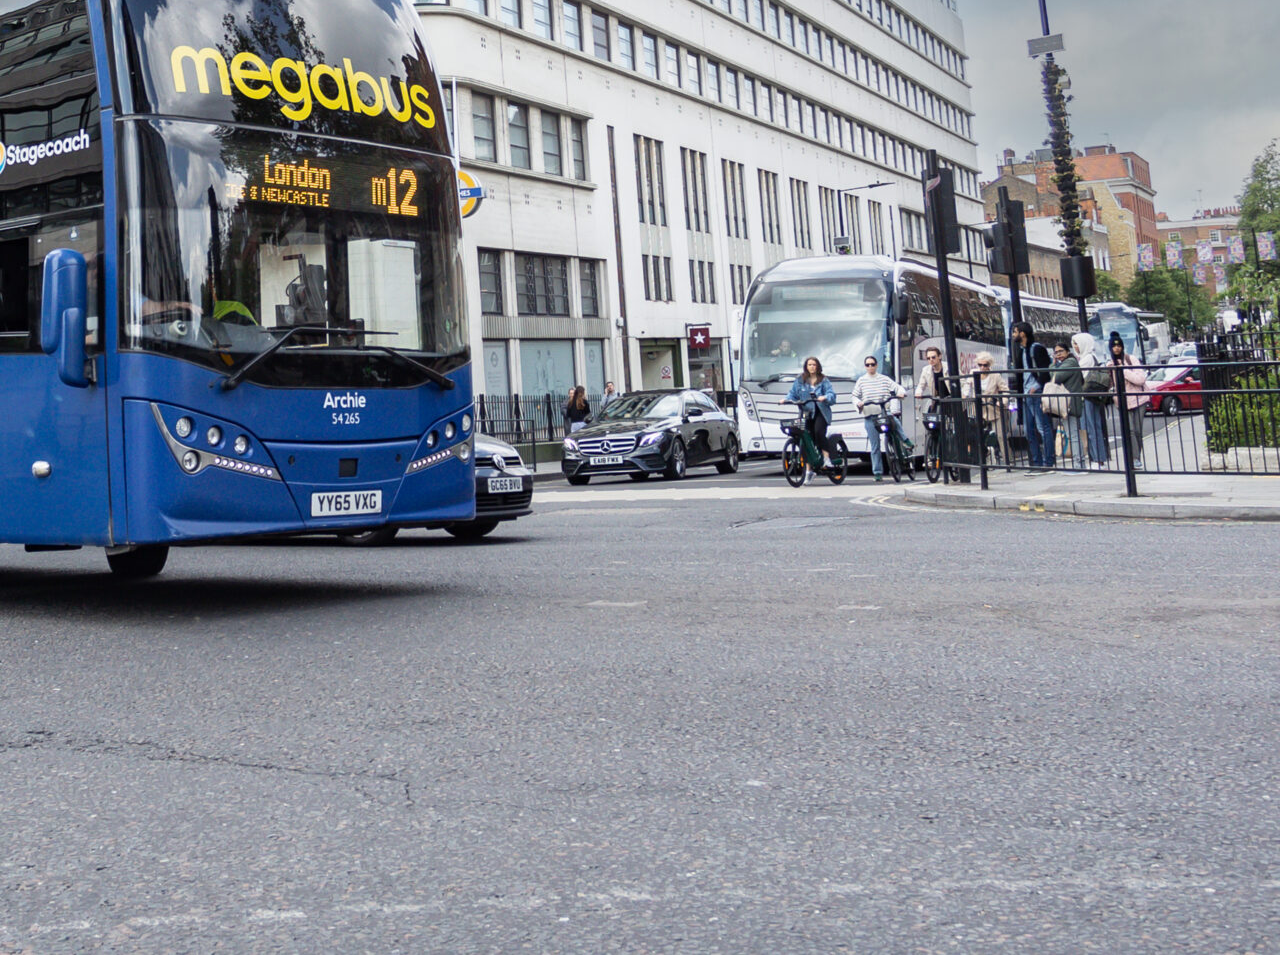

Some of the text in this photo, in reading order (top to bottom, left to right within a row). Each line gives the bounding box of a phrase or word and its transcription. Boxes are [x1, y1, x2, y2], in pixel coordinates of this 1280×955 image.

[170, 45, 435, 129] megabus
[6, 129, 90, 165] Stagecoach
[264, 154, 331, 190] London
[262, 187, 330, 208] NEWCASTLE
[372, 167, 418, 217] m12
[323, 392, 367, 408] Archie
[491, 479, 508, 491] GC65
[318, 493, 377, 512] YY65 VXG
